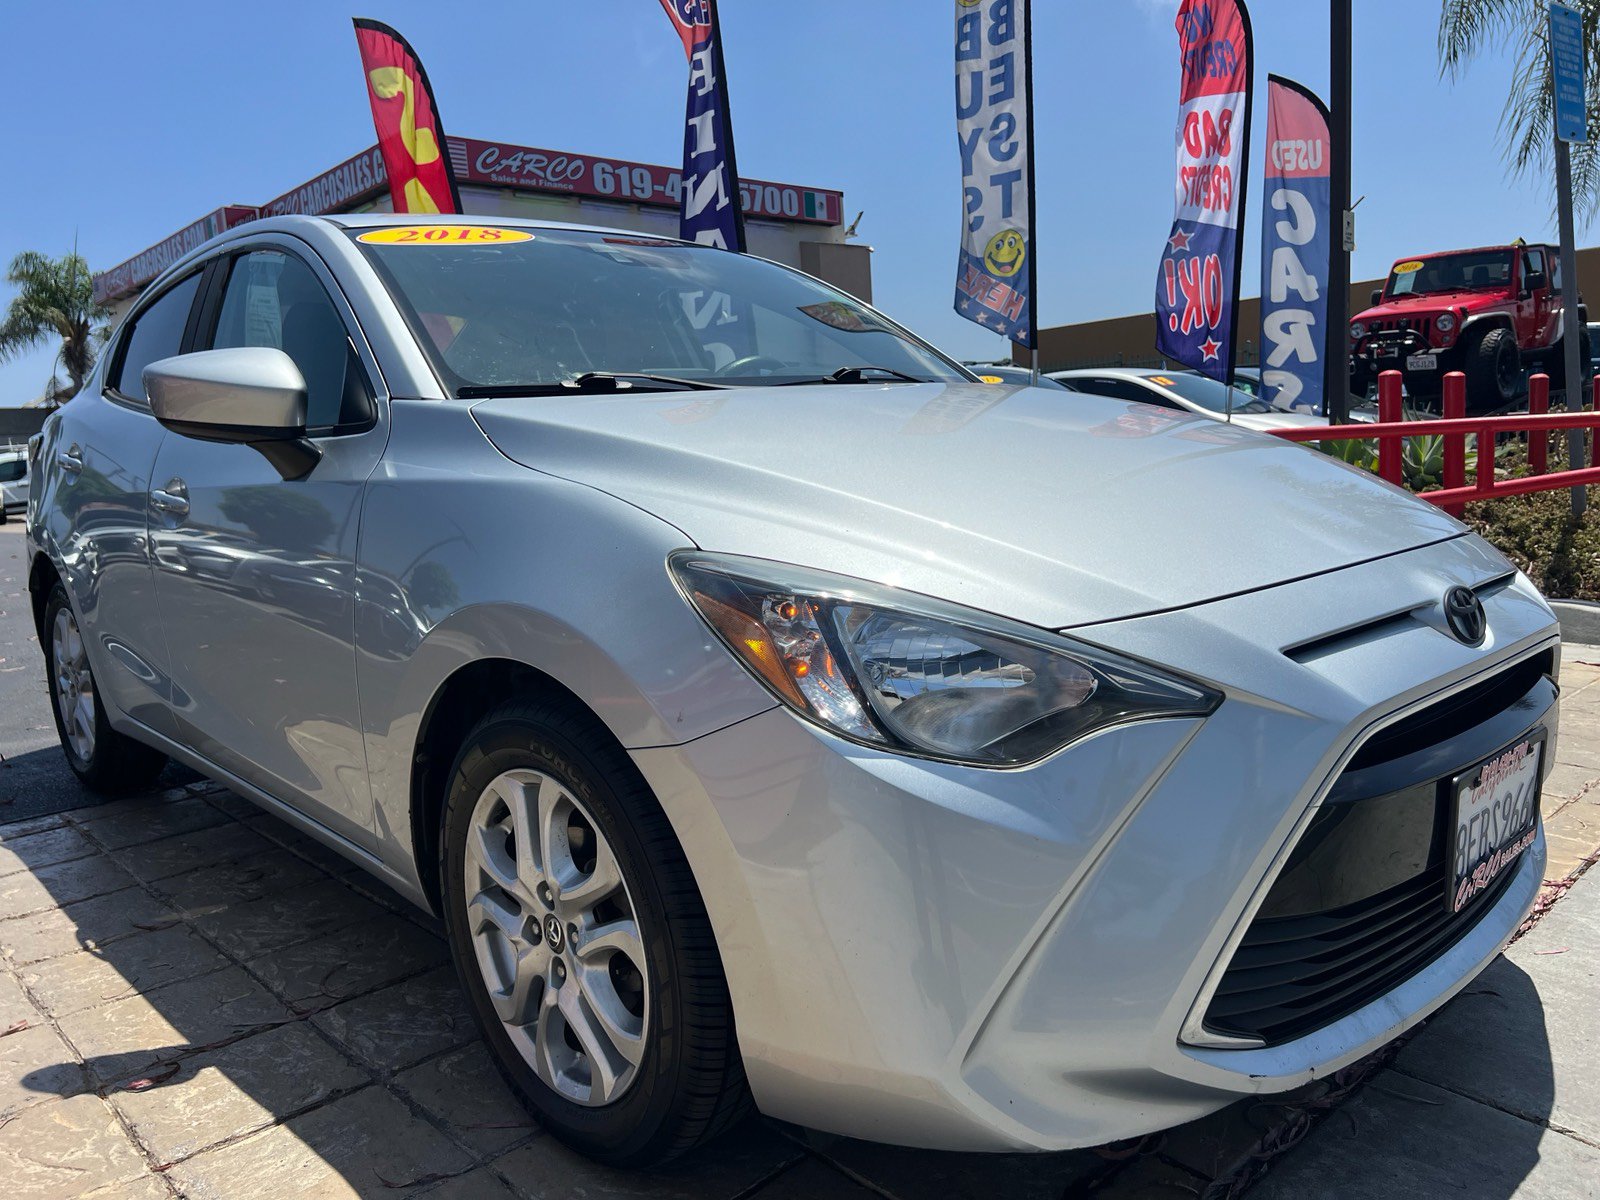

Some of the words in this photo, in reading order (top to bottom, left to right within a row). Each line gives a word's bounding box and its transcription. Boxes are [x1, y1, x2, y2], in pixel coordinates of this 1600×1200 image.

[475, 146, 585, 182] CARCO
[299, 148, 389, 216] CARCOSALES.C
[490, 173, 517, 186] Sales
[520, 177, 536, 187] and
[538, 179, 574, 191] Finance
[396, 228, 503, 243] 2018
